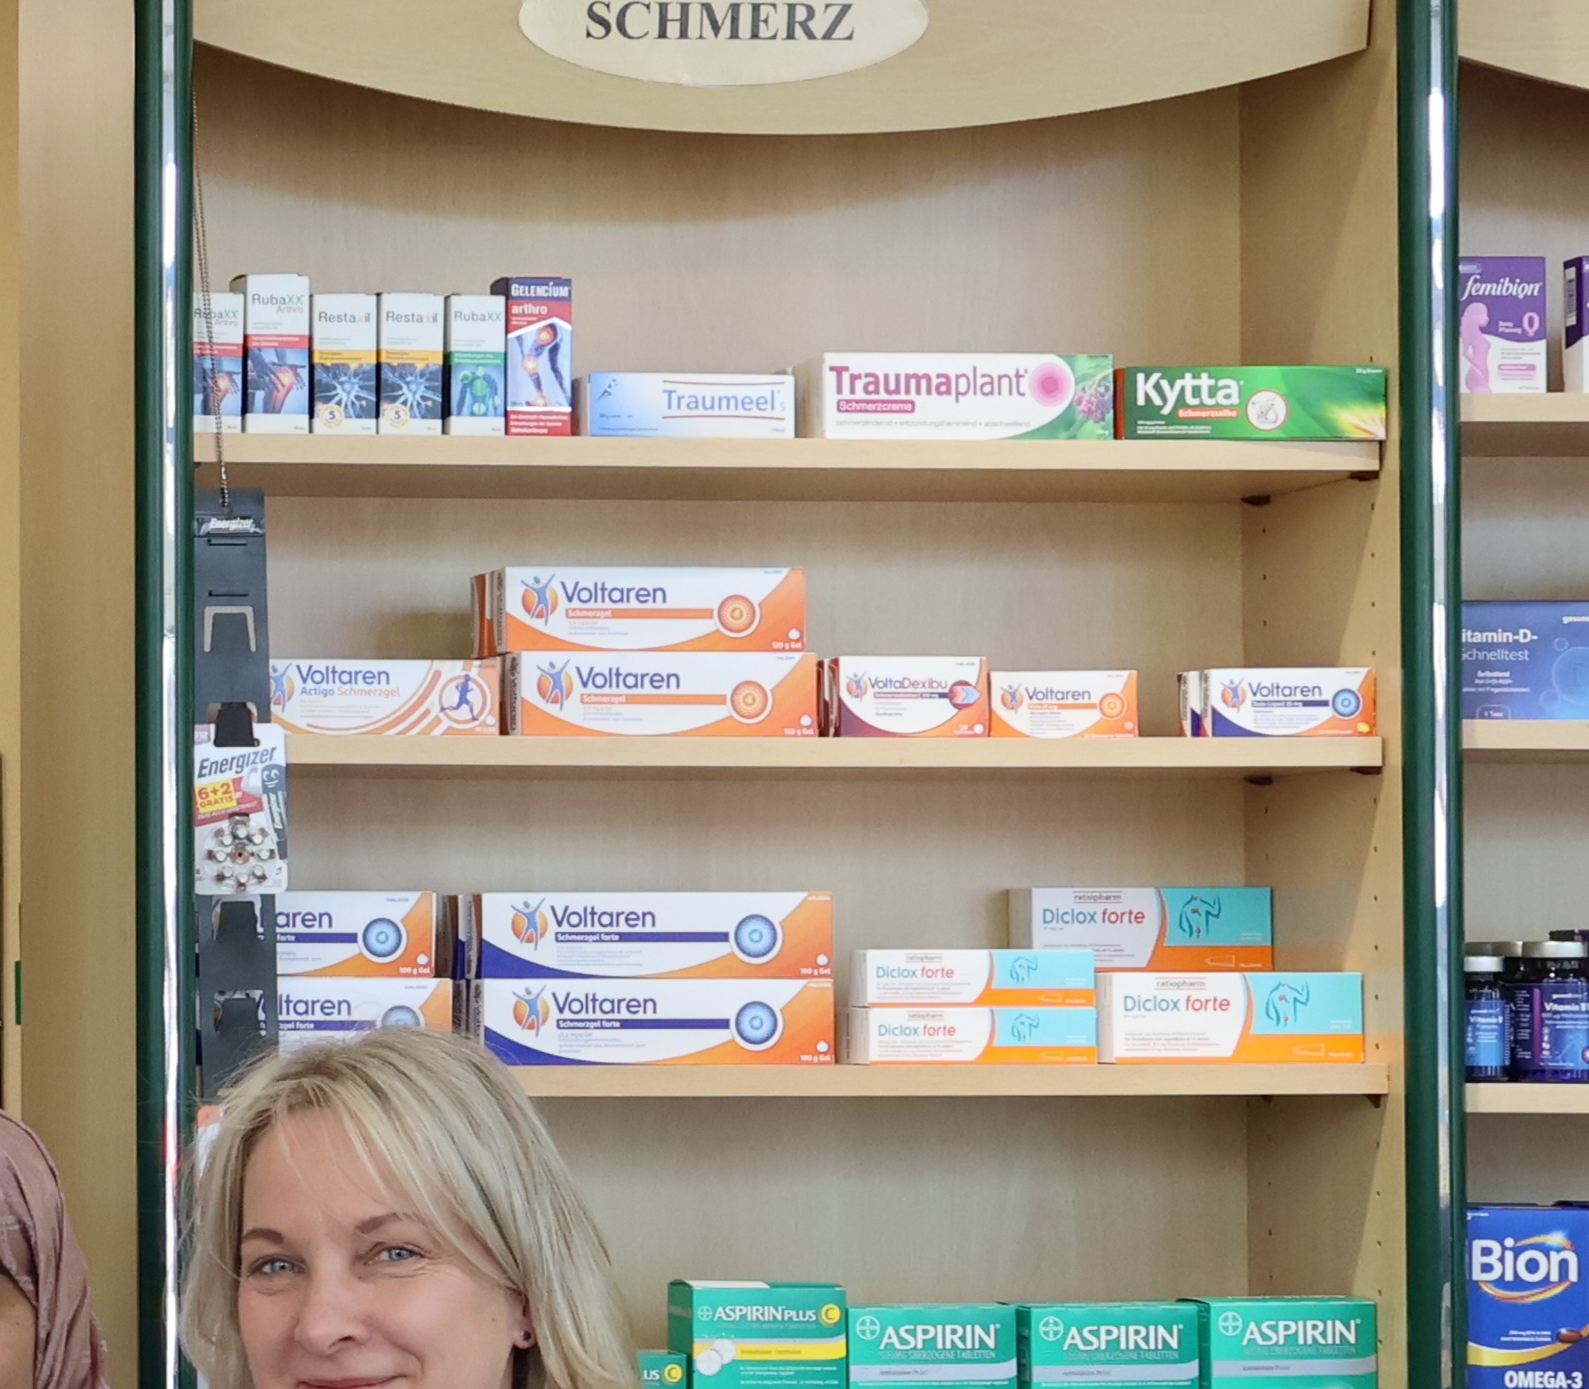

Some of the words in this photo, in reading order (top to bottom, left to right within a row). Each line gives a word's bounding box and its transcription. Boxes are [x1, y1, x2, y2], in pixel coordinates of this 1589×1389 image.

[585, 0, 855, 41] SCHMERZ
[1460, 275, 1540, 301] femibion
[252, 293, 303, 306] RubaXX
[318, 311, 370, 324] Restaxil
[386, 311, 438, 324] Restaxil
[454, 311, 502, 323] RubaXX
[512, 304, 548, 316] arthro
[829, 366, 1025, 403] Traumaplant
[1136, 371, 1240, 415] Kytta
[663, 389, 775, 411] Traumeel
[839, 401, 913, 412] Schmerzcreme
[561, 581, 667, 604] Voltaren
[1462, 628, 1538, 643] itamin-D-
[297, 664, 390, 686] Voltaren
[576, 667, 680, 690] Voltaren
[868, 677, 948, 690] VoltaDexibu
[300, 687, 336, 699] Actigo
[337, 687, 400, 699] Schmerzgel
[1025, 687, 1091, 701] Voltaren
[1247, 682, 1322, 698] Voltaren
[198, 747, 276, 778] Energizer
[199, 795, 236, 808] GRATIS
[1074, 893, 1122, 903] ratiopharm
[551, 905, 655, 928] Voltaren
[1042, 908, 1097, 925] Diclox
[1101, 907, 1145, 925] forte
[876, 966, 917, 979] Diclox
[920, 966, 954, 979] forte
[1156, 980, 1206, 990] ratiopharm
[552, 991, 657, 1015] Voltaren
[1123, 995, 1180, 1012] Diclox
[1184, 994, 1230, 1012] forte
[878, 1024, 919, 1037] Diclox
[922, 1024, 956, 1037] forte
[1472, 1237, 1578, 1282] Bion
[714, 1306, 782, 1321] ASPIRIN
[784, 1310, 816, 1321] PLUS
[879, 1324, 996, 1350] ASPIRIN
[1063, 1325, 1179, 1350] ASPIRIN
[1241, 1321, 1357, 1345] ASPIRIN
[1504, 1370, 1583, 1389] OMEGA-3
